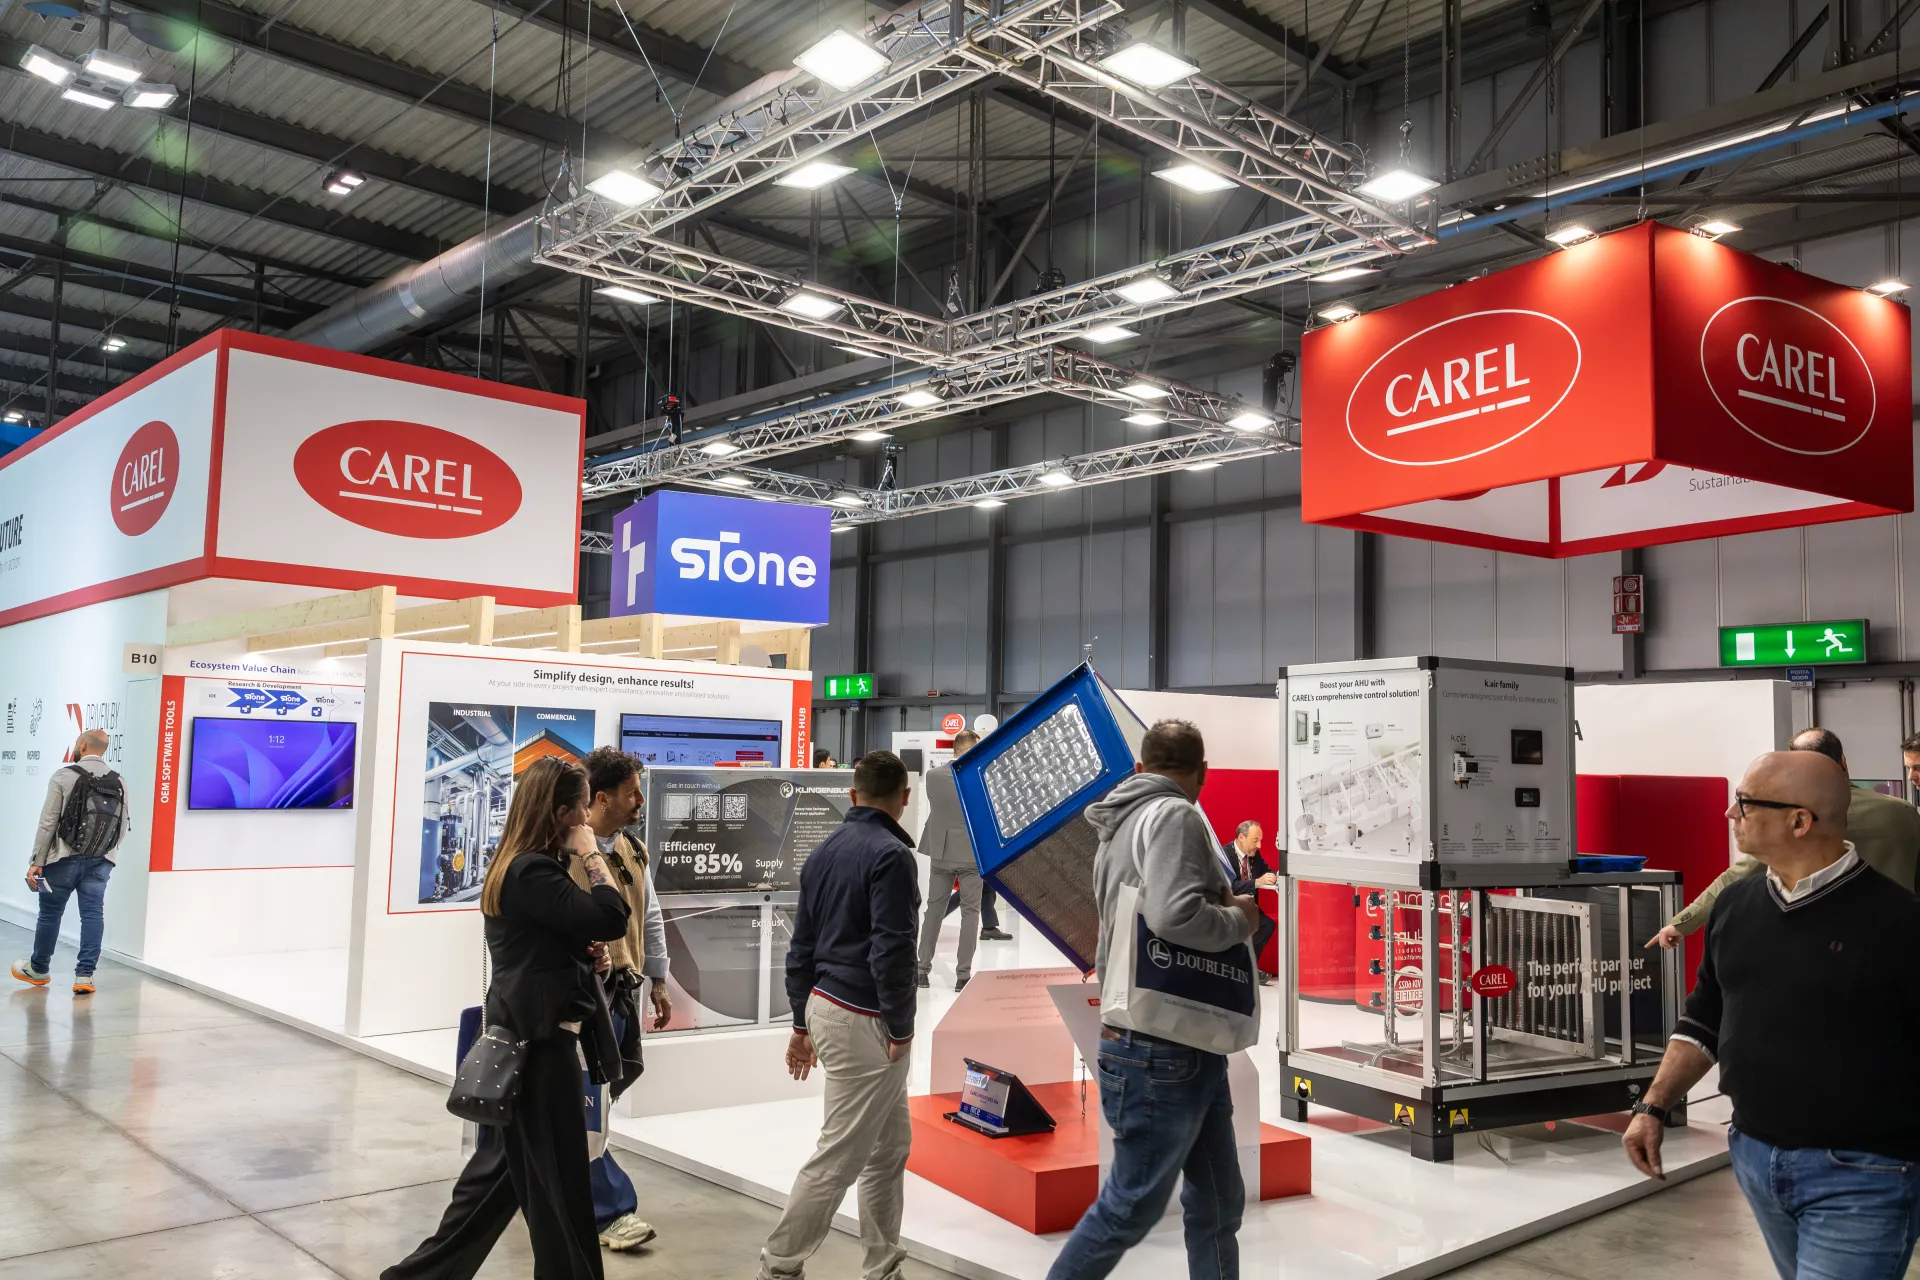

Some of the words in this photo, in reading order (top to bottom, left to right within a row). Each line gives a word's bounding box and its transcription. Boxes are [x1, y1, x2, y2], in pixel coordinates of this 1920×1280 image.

[1738, 332, 1846, 404] CAREL
[1386, 341, 1531, 418] CAREL
[121, 447, 166, 498] CAREL
[340, 446, 483, 502] CAREL
[131, 653, 157, 665] B10
[190, 660, 240, 672] Ecosystem
[242, 663, 268, 673] Value
[270, 665, 296, 675] Chain
[228, 680, 256, 688] Research
[262, 682, 302, 690] Development
[533, 669, 577, 683] Simplify
[579, 672, 615, 685] design,
[617, 675, 658, 686] enhance
[660, 678, 694, 689] results!
[1320, 681, 1338, 689] Boost
[1338, 680, 1353, 690] your
[1370, 678, 1386, 686] with
[1484, 679, 1498, 688] k.air
[1500, 680, 1520, 691] family
[1292, 694, 1314, 702] CAREL's
[1316, 692, 1363, 702] comprehensive
[1364, 691, 1388, 699] control
[1389, 689, 1420, 698] solution!
[86, 703, 110, 730] DRIVEN
[110, 702, 121, 730] BY
[166, 700, 176, 730] TOOLS
[453, 709, 492, 718] INDUSTRIAL
[536, 713, 577, 721] COMMERCIAL
[798, 708, 806, 729] HUB
[945, 718, 960, 727] CAREL
[268, 735, 285, 744] 1:12
[797, 730, 806, 768] OJECTS
[162, 731, 174, 781] SOFTWARE
[160, 782, 170, 804] OEM
[664, 841, 716, 854] Efficiency
[664, 856, 678, 866] up
[680, 854, 692, 864] to
[694, 854, 742, 874] 85%
[756, 858, 784, 870] Supply
[763, 870, 776, 878] Air
[1176, 952, 1249, 984] DOUBLE-LIN
[1527, 960, 1550, 976] The
[1554, 958, 1598, 980] perfect
[1600, 958, 1644, 976] parner
[1480, 972, 1508, 986] CAREL
[1528, 982, 1546, 998] for
[1548, 983, 1576, 1000] your
[1610, 976, 1652, 996] prject
